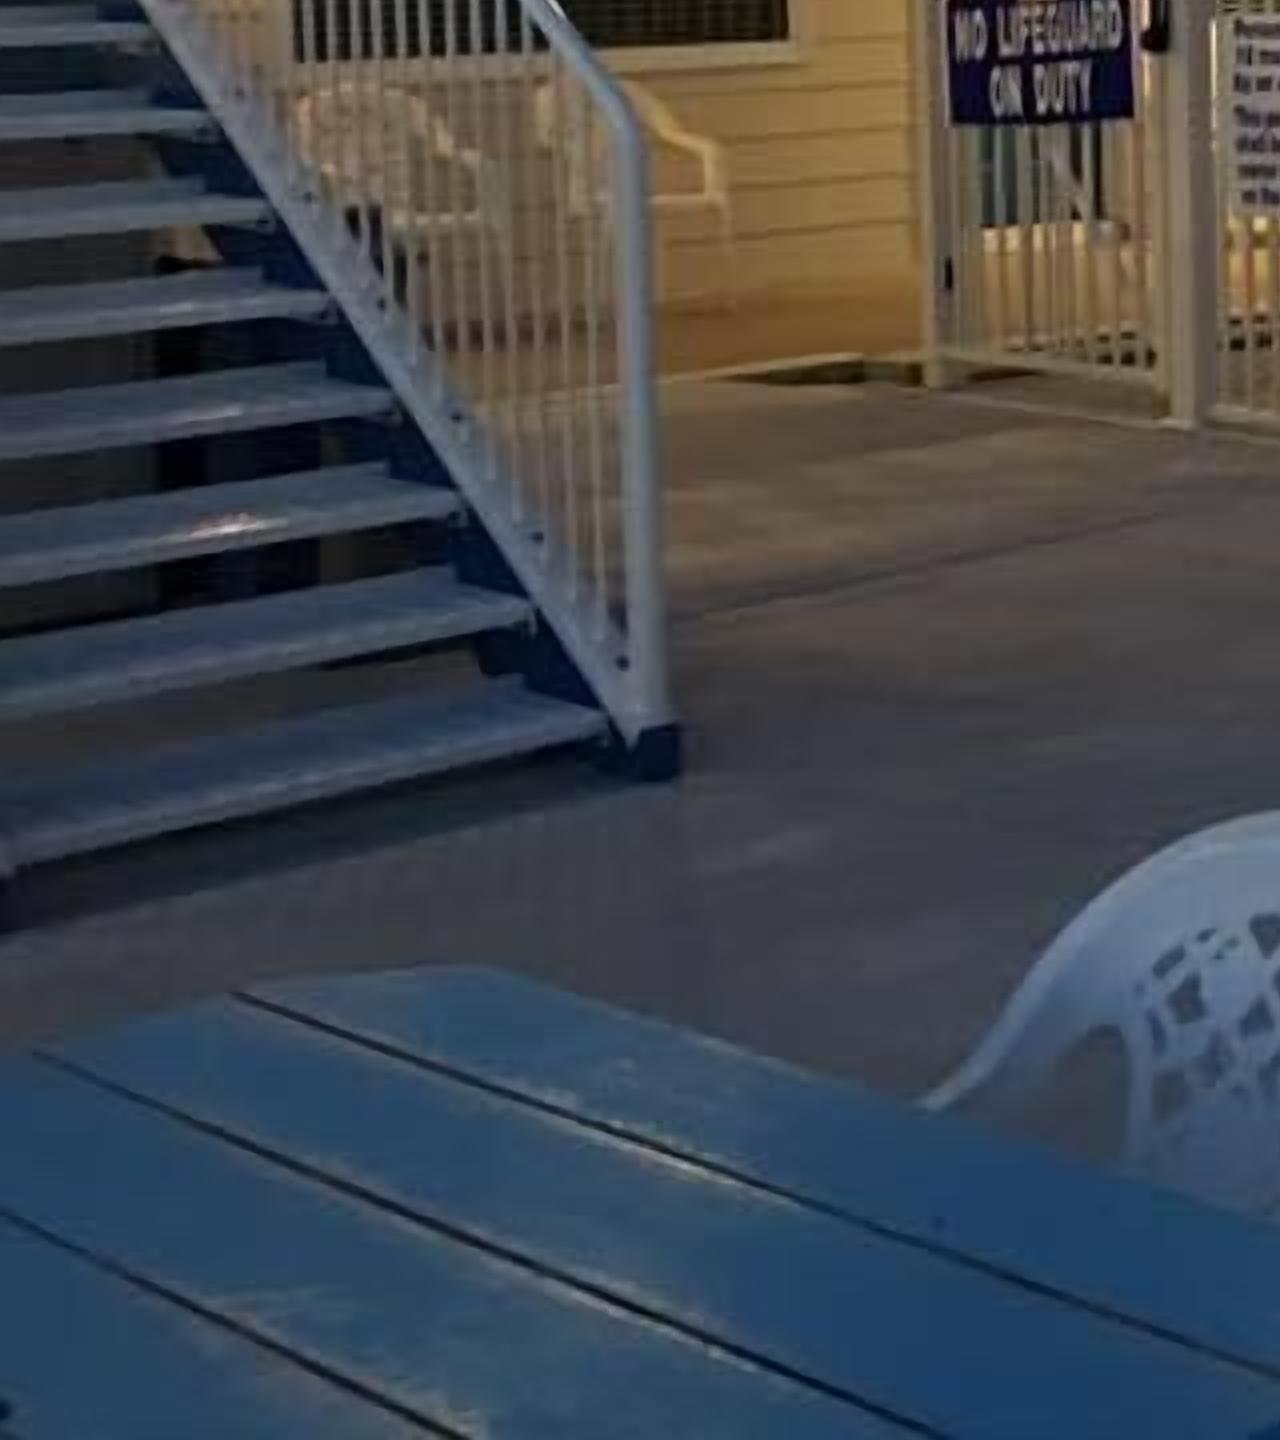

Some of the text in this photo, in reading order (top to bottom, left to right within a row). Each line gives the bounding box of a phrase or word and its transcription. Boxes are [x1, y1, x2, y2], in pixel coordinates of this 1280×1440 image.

[955, 8, 988, 63] NO
[989, 60, 1092, 118] ON DUTY
